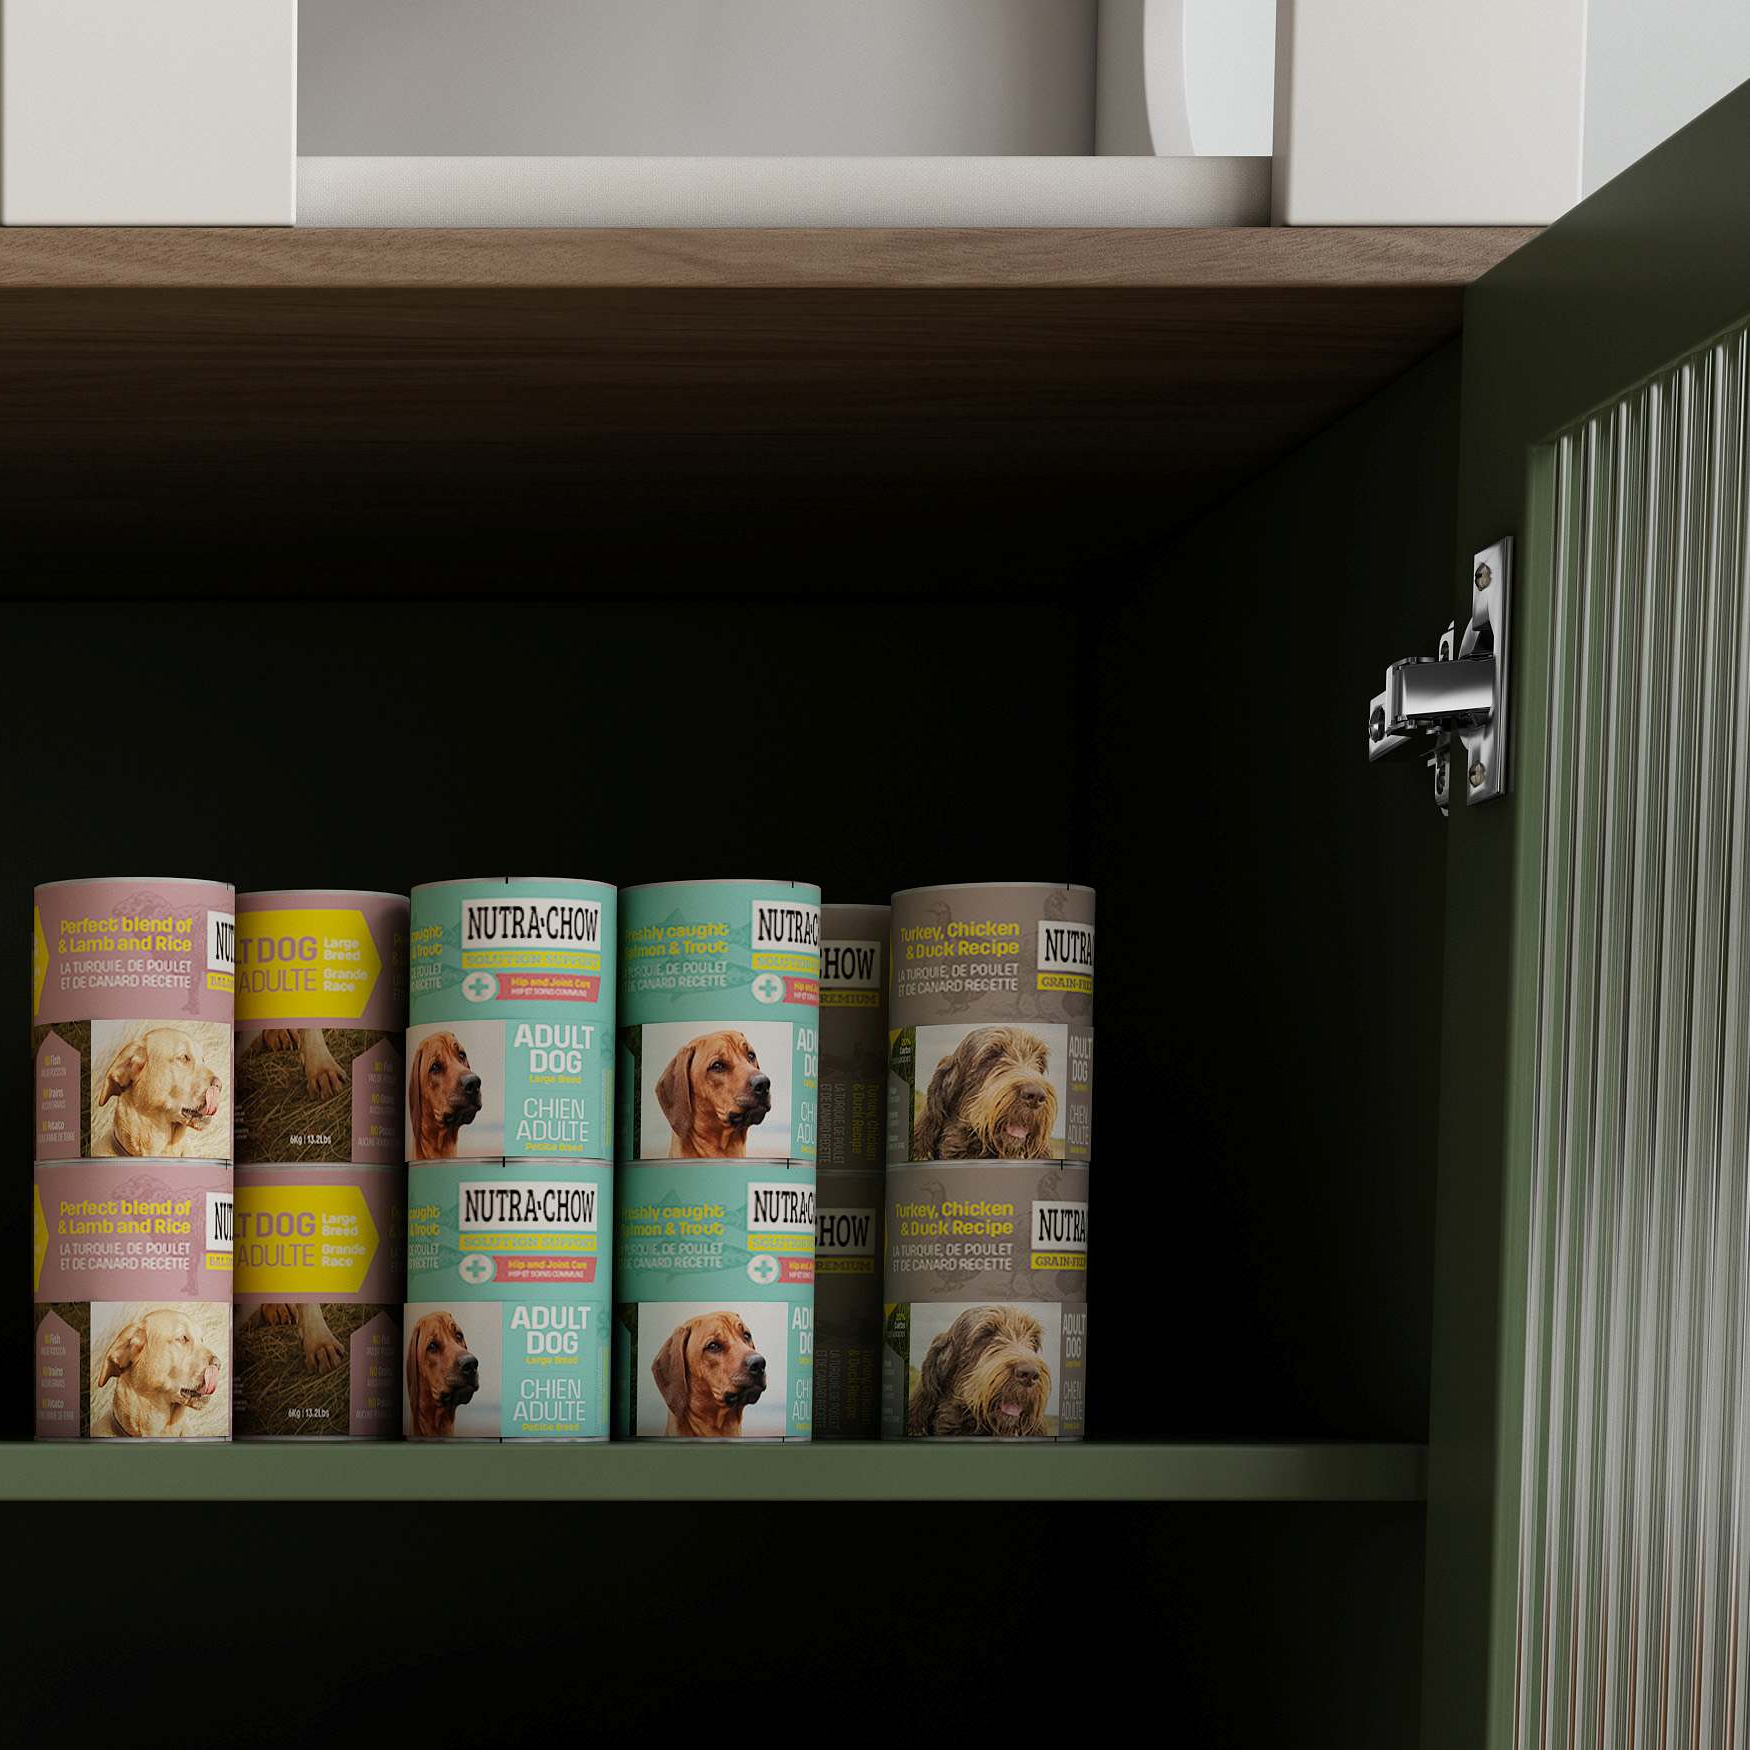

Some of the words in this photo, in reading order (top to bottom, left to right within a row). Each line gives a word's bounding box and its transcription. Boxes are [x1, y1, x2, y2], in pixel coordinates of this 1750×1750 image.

[900, 927, 945, 943] Turkey,
[947, 920, 1019, 937] Chicken
[917, 943, 955, 958] Duck
[958, 940, 1019, 957] Recipe
[952, 965, 967, 977] DE
[969, 963, 1019, 977] POULET
[917, 979, 963, 994] CANARD
[965, 978, 1018, 991] RECETTE
[60, 1201, 118, 1216] Perfect
[120, 1199, 172, 1215] blend
[174, 1199, 192, 1215] of
[58, 1220, 68, 1234] &
[69, 1219, 114, 1234] Lamb
[116, 1219, 151, 1234] and
[154, 1219, 192, 1234] Rice
[255, 1212, 316, 1238] DOG
[60, 1244, 70, 1255] LA
[126, 1242, 143, 1255] DE
[145, 1242, 191, 1256] POULET
[237, 1243, 315, 1268] ADULTE
[61, 1259, 70, 1270] ET
[72, 1258, 86, 1270] DE
[88, 1257, 138, 1270] CANARD
[141, 1257, 190, 1270] RECETTE
[511, 1306, 591, 1329] ADULT
[526, 1331, 578, 1354] DOG
[520, 1379, 581, 1399] CHIEN
[513, 1401, 586, 1421] ADULTE
